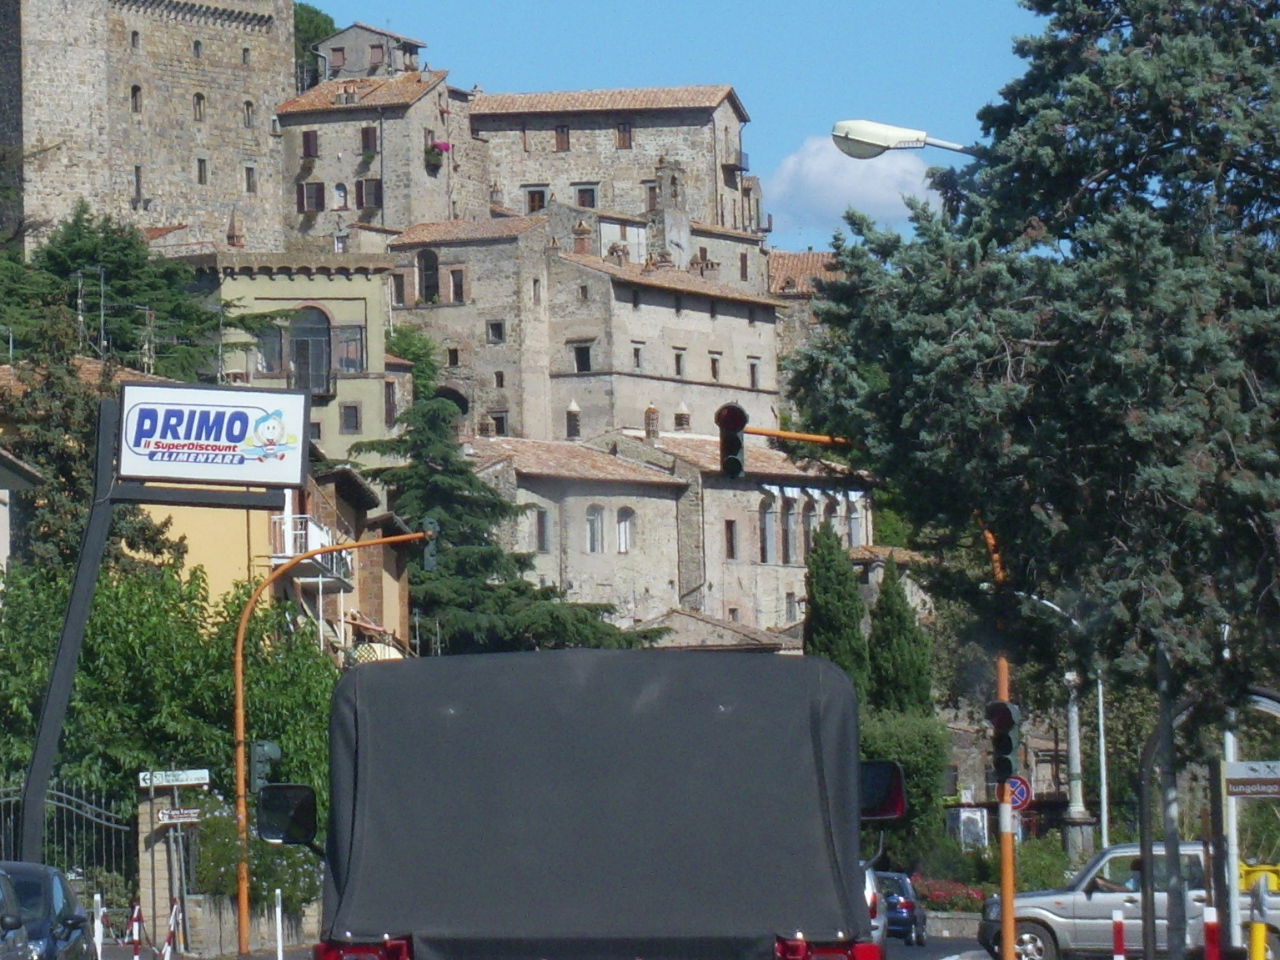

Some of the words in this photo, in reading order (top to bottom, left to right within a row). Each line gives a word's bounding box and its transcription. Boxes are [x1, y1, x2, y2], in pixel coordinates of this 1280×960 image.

[133, 408, 249, 447] PRIMO
[154, 441, 238, 452] SuperDiscount
[152, 451, 241, 464] ALIMENTARE
